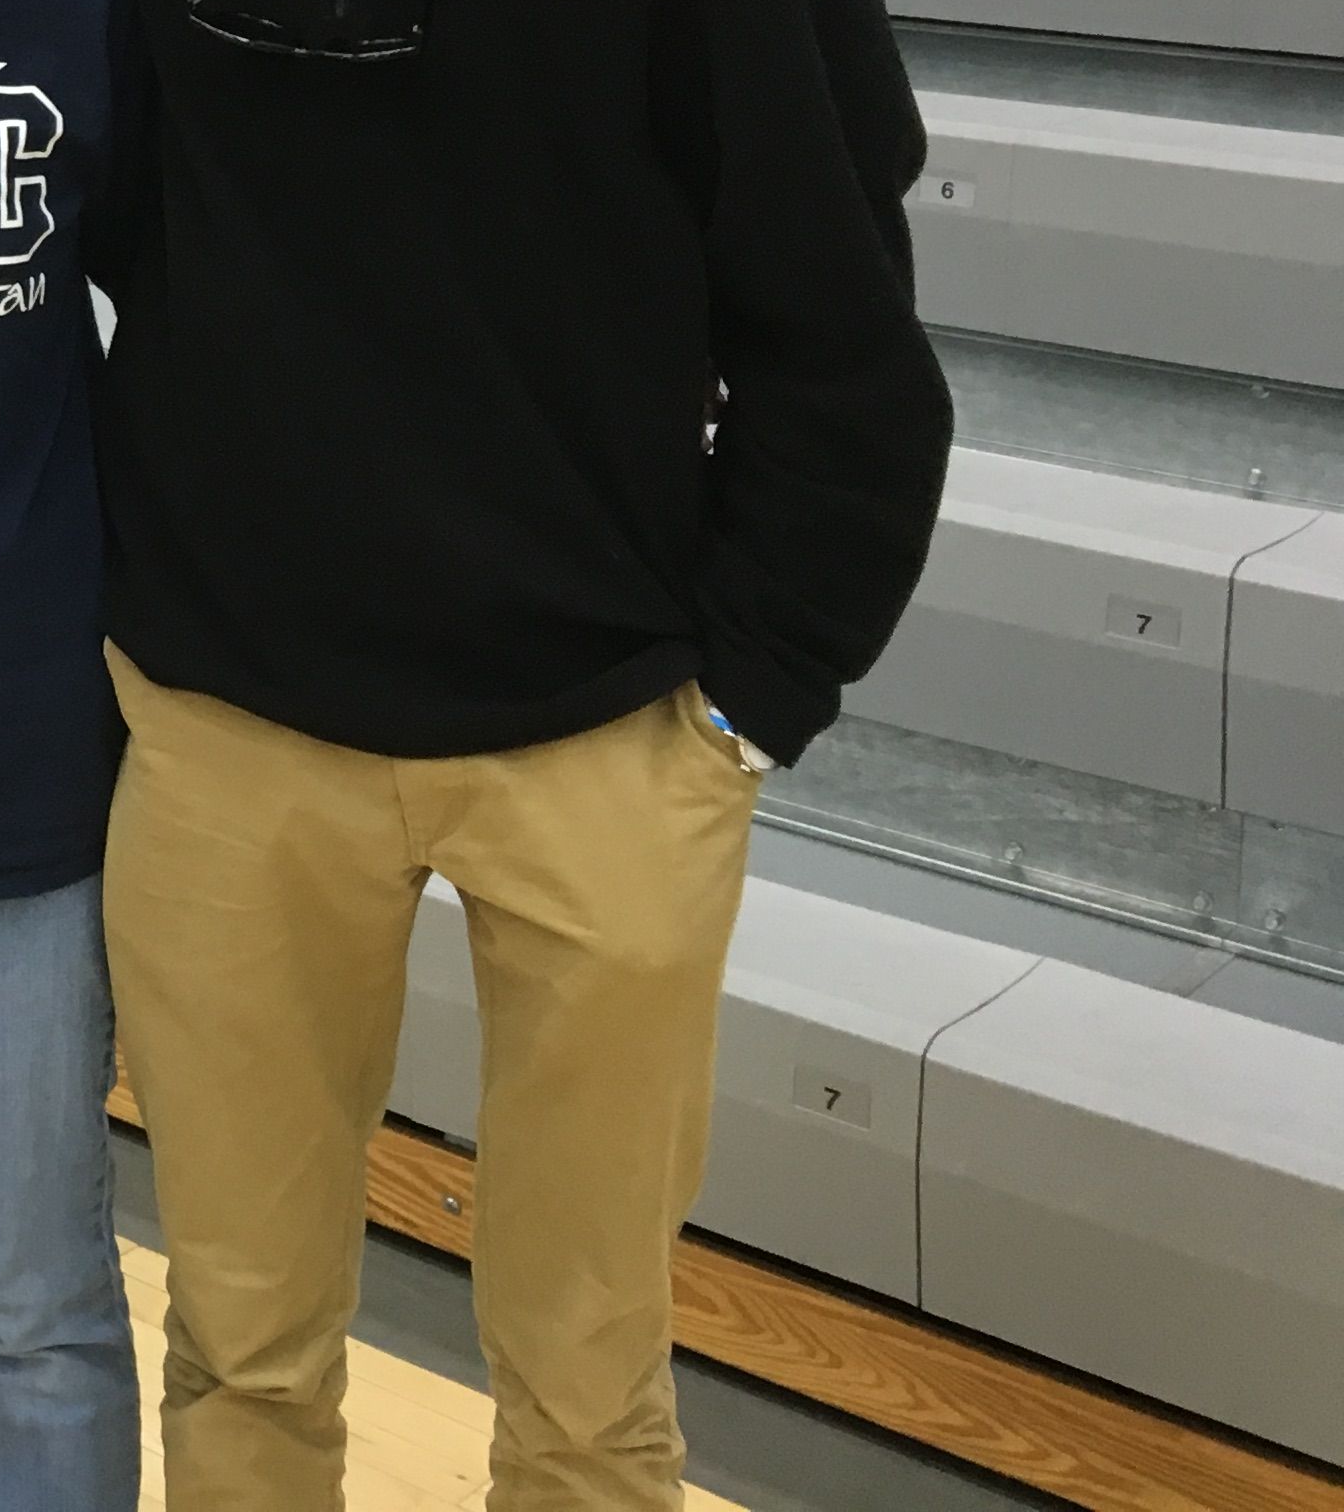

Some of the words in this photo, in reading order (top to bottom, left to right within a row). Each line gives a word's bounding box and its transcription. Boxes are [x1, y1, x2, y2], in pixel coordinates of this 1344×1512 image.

[941, 182, 953, 199] 6
[1137, 614, 1152, 634] 7
[824, 1087, 841, 1110] 7
